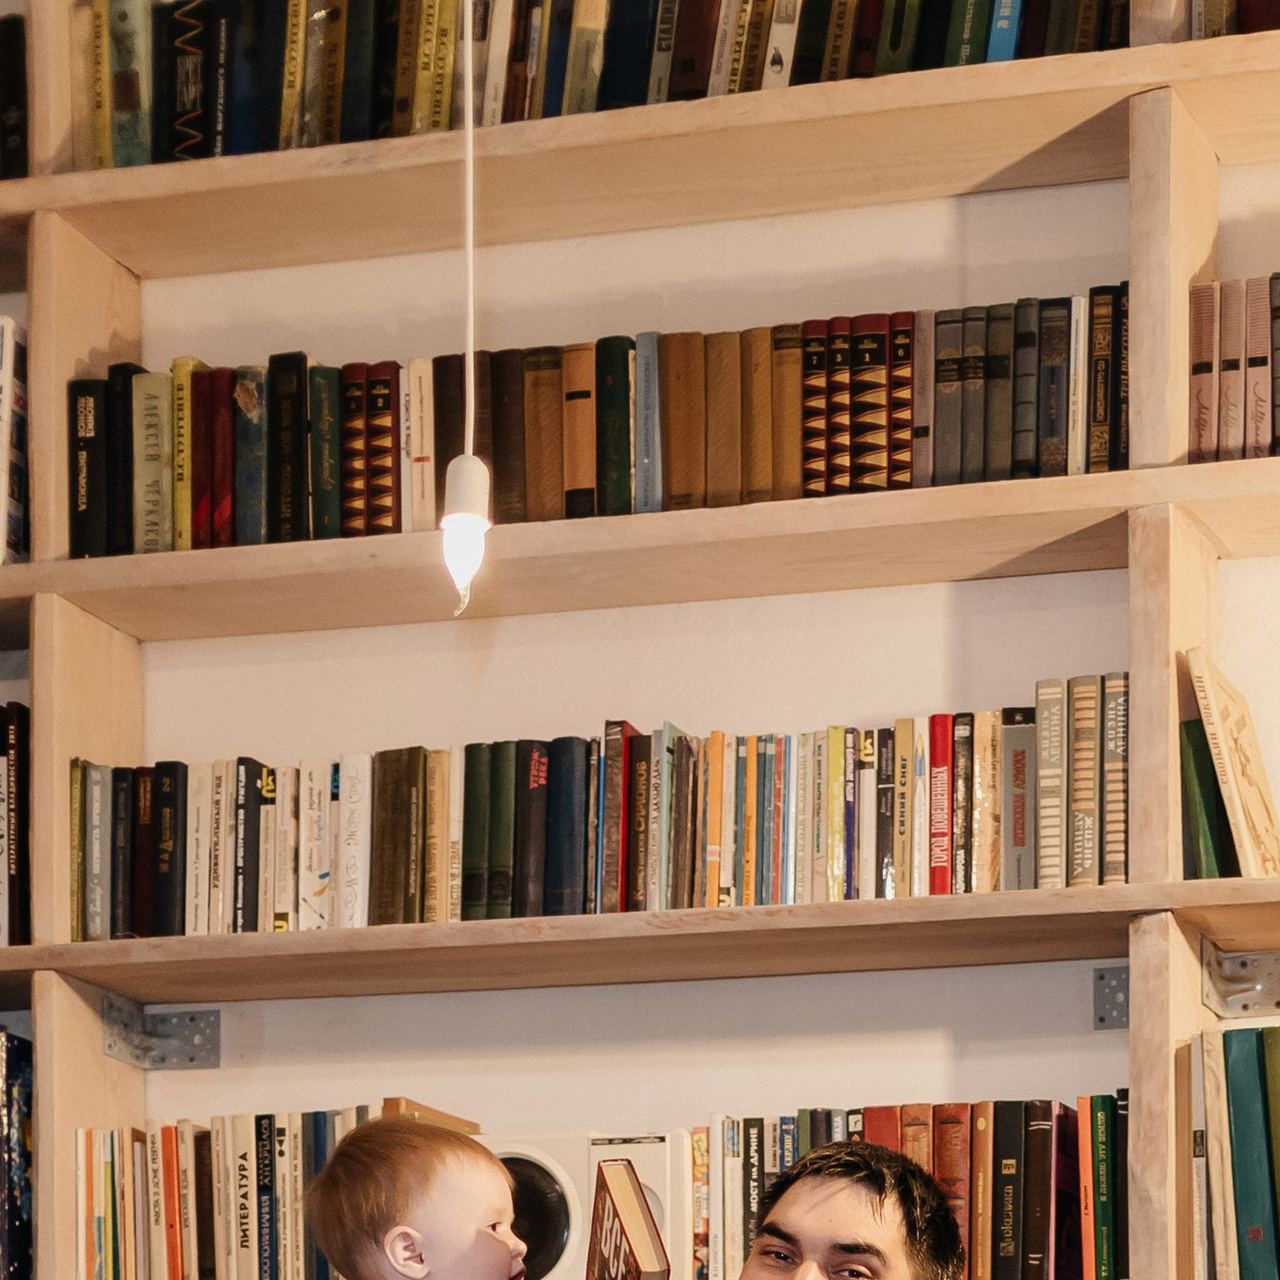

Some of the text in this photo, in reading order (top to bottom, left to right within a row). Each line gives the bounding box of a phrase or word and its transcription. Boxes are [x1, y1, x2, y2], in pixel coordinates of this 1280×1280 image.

[1041, 711, 1050, 760] ЖИЗНЬ
[1051, 705, 1061, 763] ЛЕНИНА
[899, 754, 908, 787] СНЕГ
[897, 792, 906, 836] СИНИЙ
[931, 765, 949, 867] ГОРОД ПОВЕШЕННЫХ
[1084, 815, 1093, 867] ЖИЗНЬ
[239, 1151, 250, 1250] ЛИТЕРАТУРА
[750, 1180, 758, 1213] МОСТ
